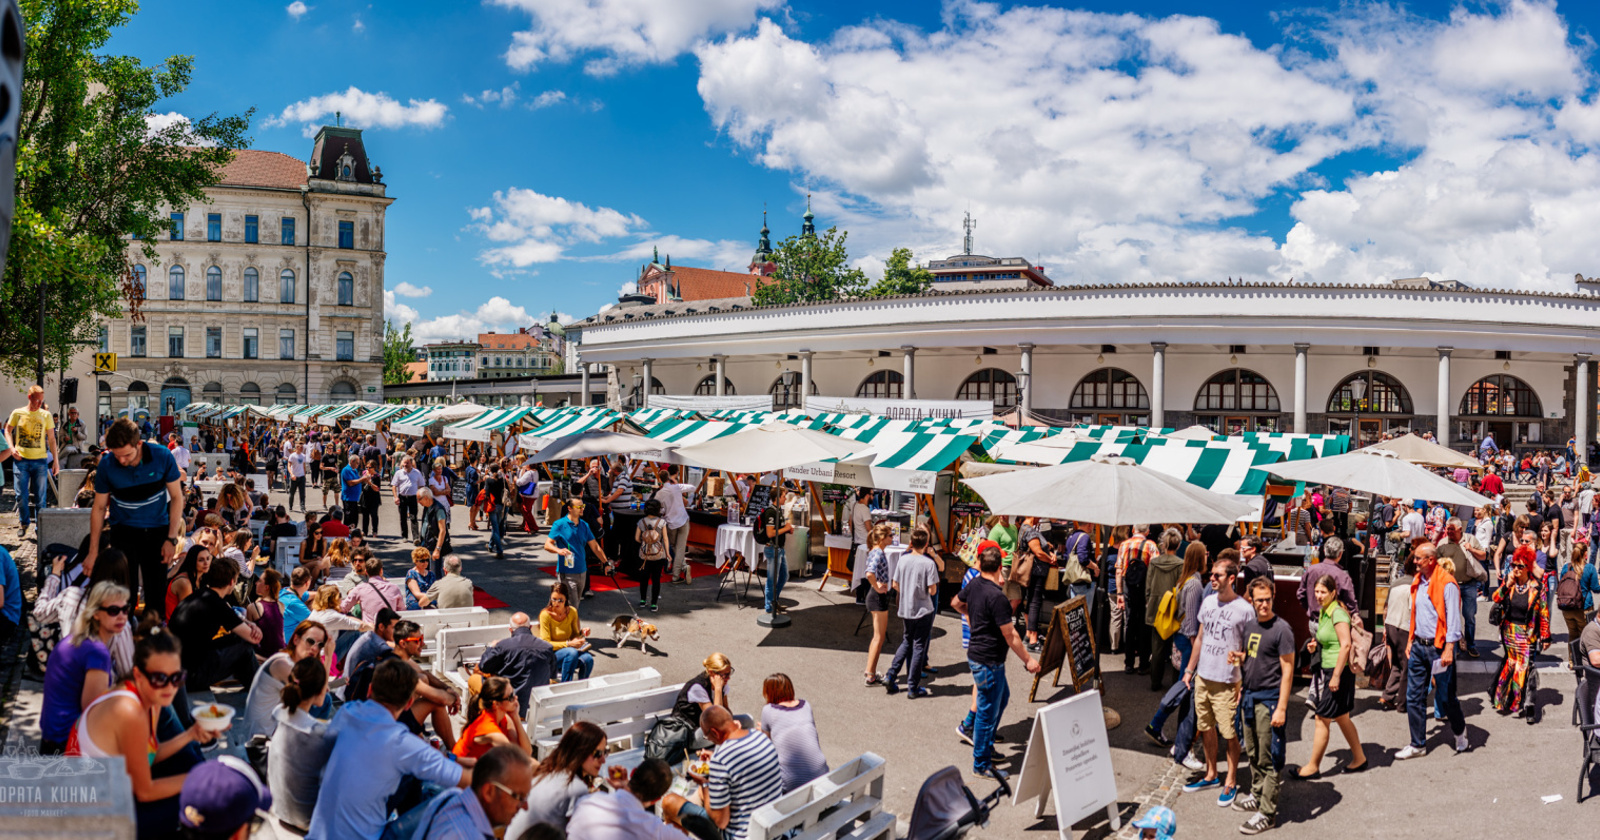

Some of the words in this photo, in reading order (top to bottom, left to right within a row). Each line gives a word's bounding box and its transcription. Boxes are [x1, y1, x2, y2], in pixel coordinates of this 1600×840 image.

[811, 468, 832, 477] Urbani
[834, 470, 856, 480] Resort
[1219, 610, 1233, 621] ALL
